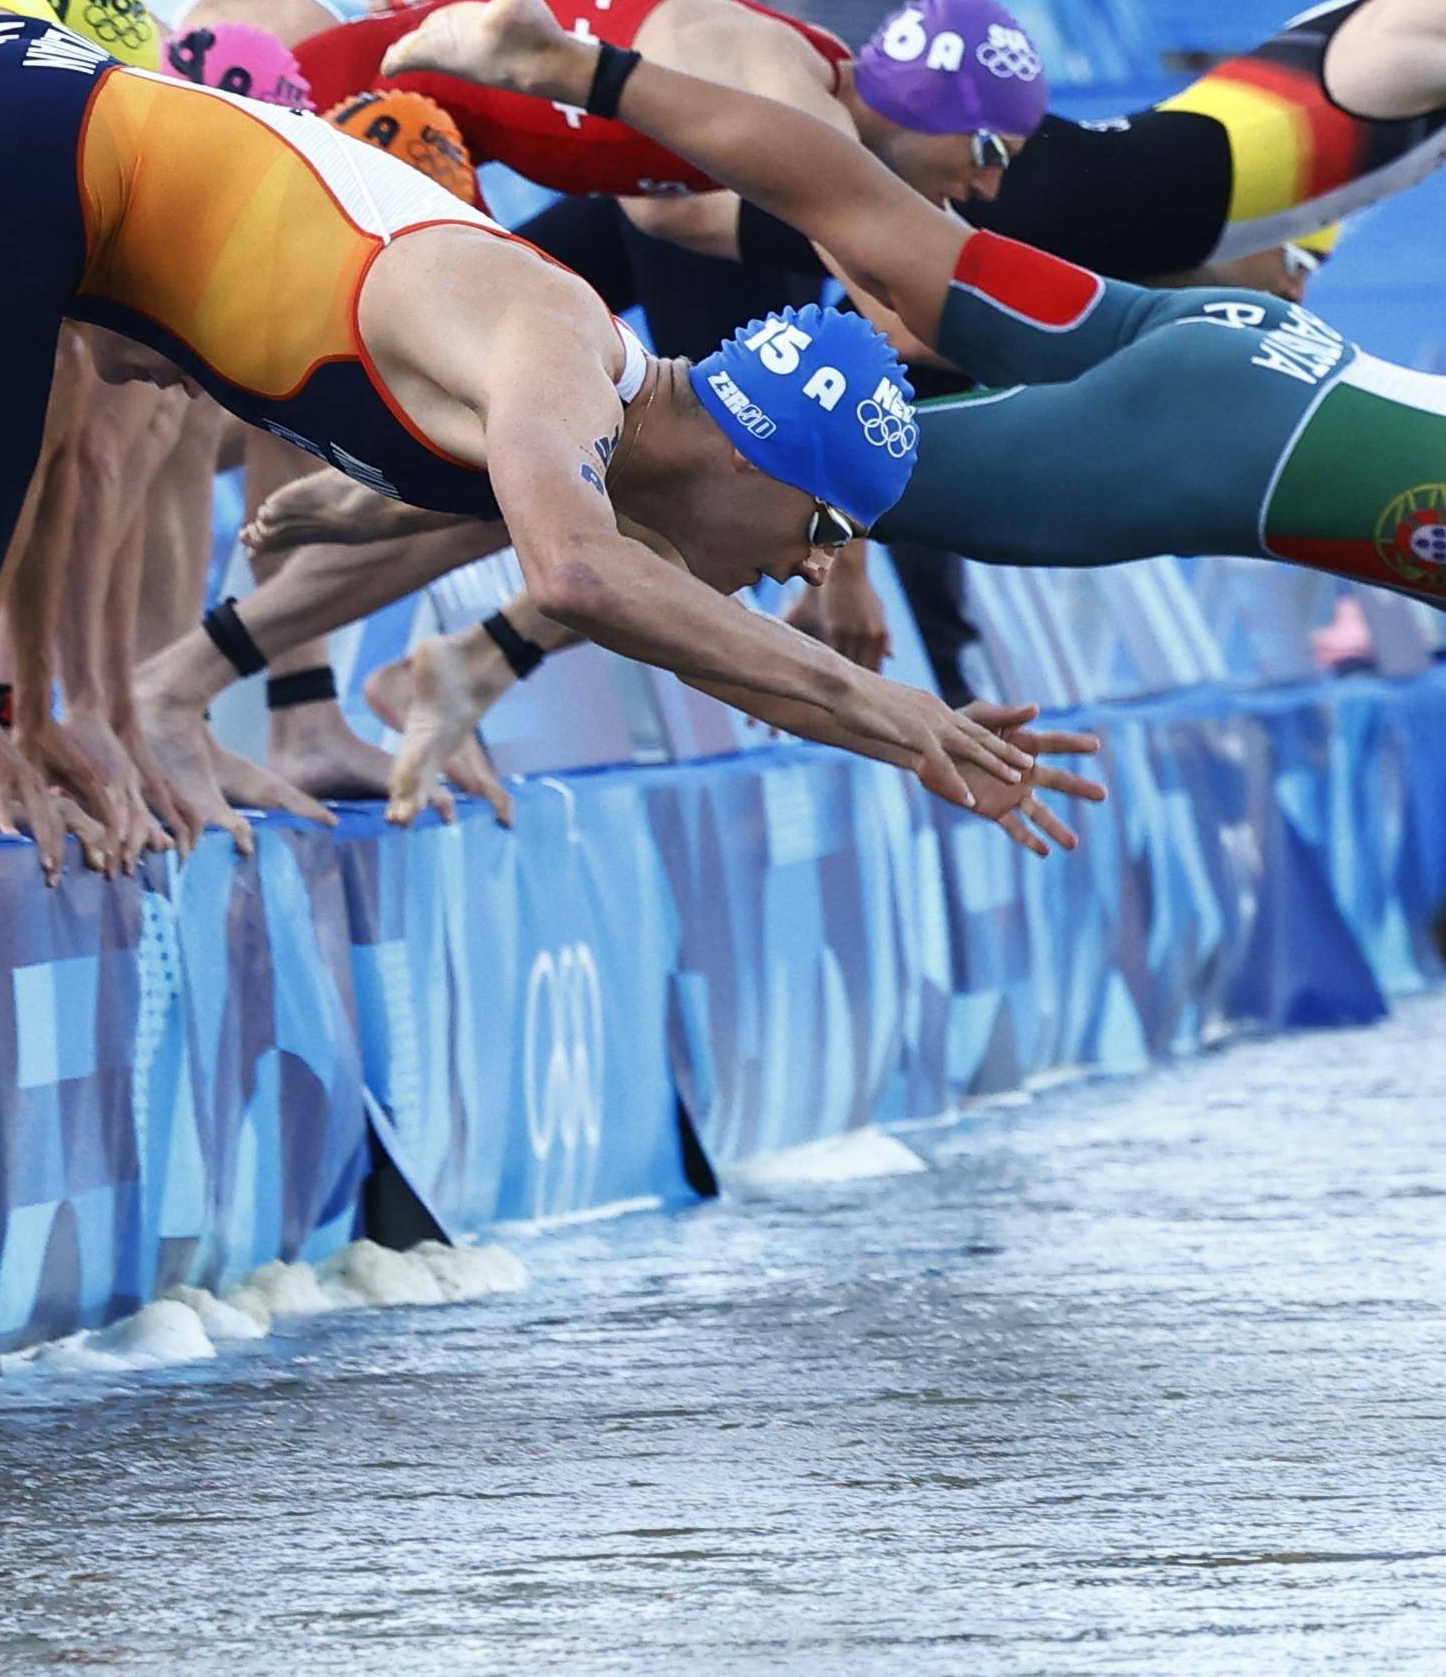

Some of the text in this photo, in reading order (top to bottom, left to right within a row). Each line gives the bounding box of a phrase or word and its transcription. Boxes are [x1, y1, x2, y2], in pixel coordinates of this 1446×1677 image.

[882, 7, 965, 73] 6 A
[364, 116, 400, 147] A
[743, 318, 847, 412] 15 A
